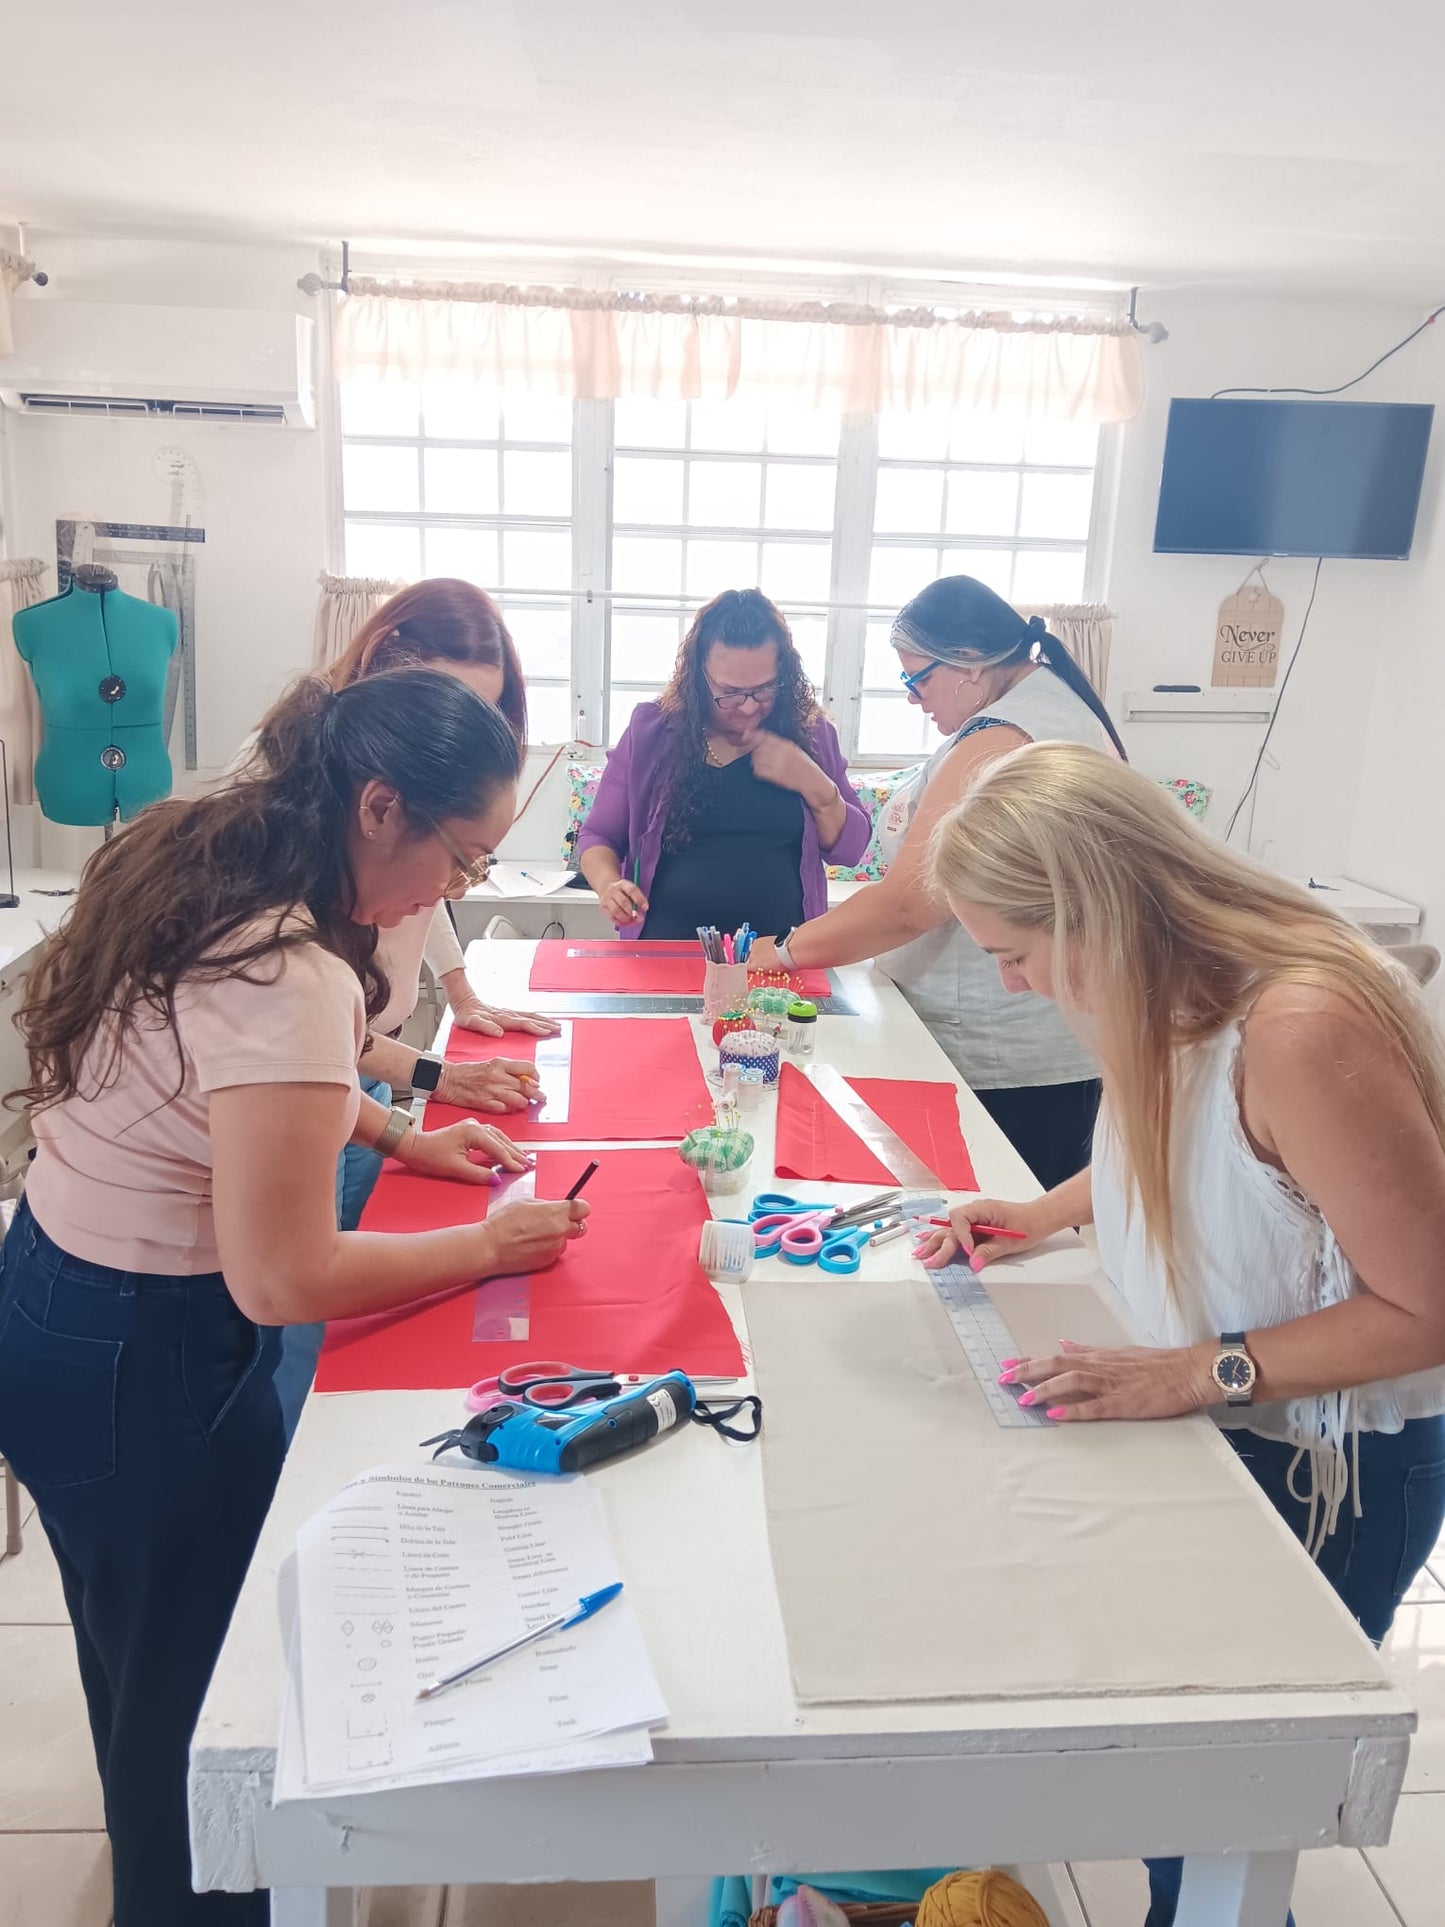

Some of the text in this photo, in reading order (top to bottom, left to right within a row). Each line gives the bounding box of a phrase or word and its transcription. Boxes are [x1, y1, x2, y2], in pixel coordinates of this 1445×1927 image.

[1220, 624, 1276, 651] Never
[1222, 651, 1277, 663] GIVE UP
[440, 1479, 479, 1488] Patrones
[482, 1480, 536, 1489] Comerciales
